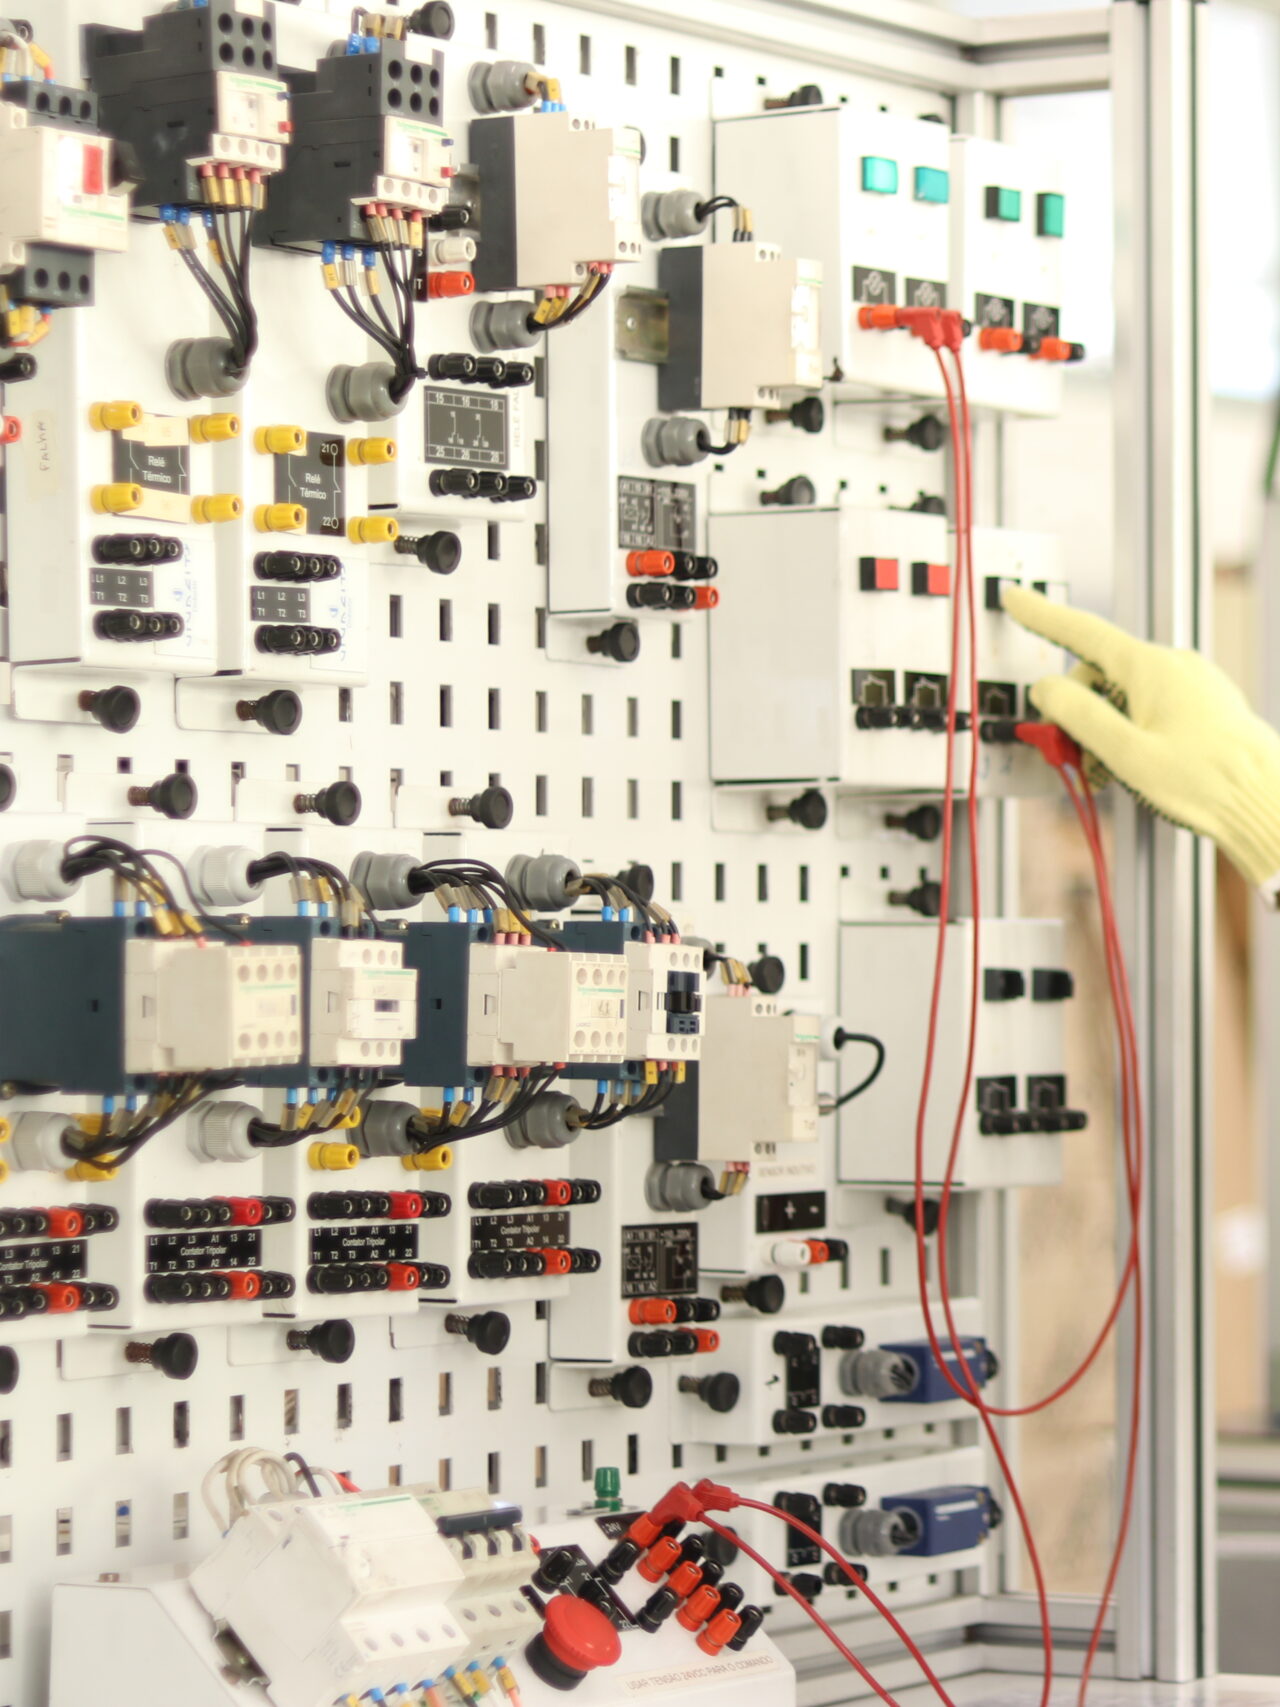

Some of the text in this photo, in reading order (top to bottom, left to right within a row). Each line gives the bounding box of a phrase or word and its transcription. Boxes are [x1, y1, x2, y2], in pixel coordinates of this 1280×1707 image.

[321, 443, 330, 453] 21
[322, 516, 331, 527] 22
[95, 574, 148, 586] L1 L2 L3
[95, 591, 149, 604] T1 T2 T3
[257, 591, 306, 602] L1 L2 L3
[257, 607, 306, 618] T1 T2 T3
[314, 1225, 413, 1237] L1 L2 L3 A1 13 21
[150, 1233, 256, 1246] L1 L2 L3 A1 13 21
[342, 1237, 386, 1247] Contator Tripolar
[4, 1244, 80, 1259] L3 A1 13 21
[180, 1246, 228, 1256] Contator Tripolar
[313, 1249, 413, 1260] T1 T2 T3 A2 14 22
[149, 1257, 256, 1271] T1 T2 T3 A2 14 22
[3, 1269, 81, 1285] T3 A2 14 22
[706, 1665, 727, 1676] PARA
[735, 1655, 774, 1670] COMANDO
